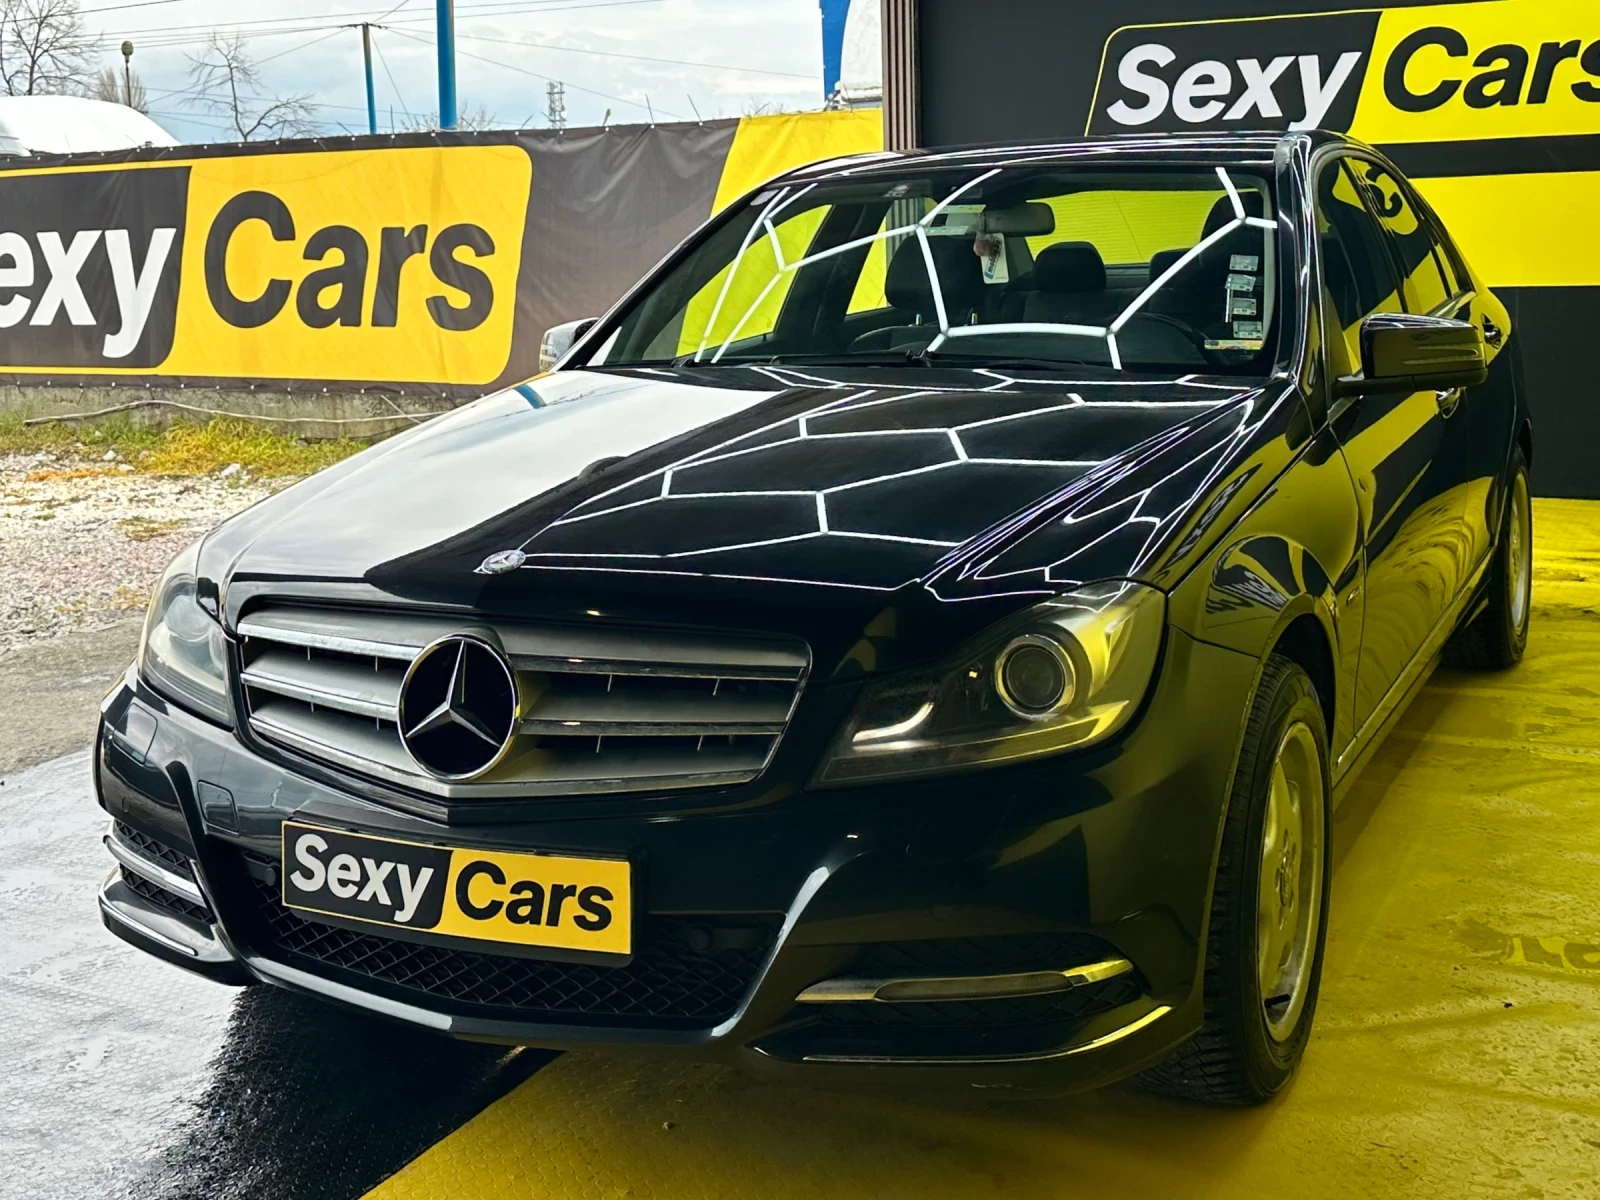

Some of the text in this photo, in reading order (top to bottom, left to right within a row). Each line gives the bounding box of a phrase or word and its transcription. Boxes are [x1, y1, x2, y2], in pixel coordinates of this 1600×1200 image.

[1106, 43, 1362, 131] Sexy
[204, 190, 495, 331] Cars
[290, 834, 613, 931] Sexy Cars
